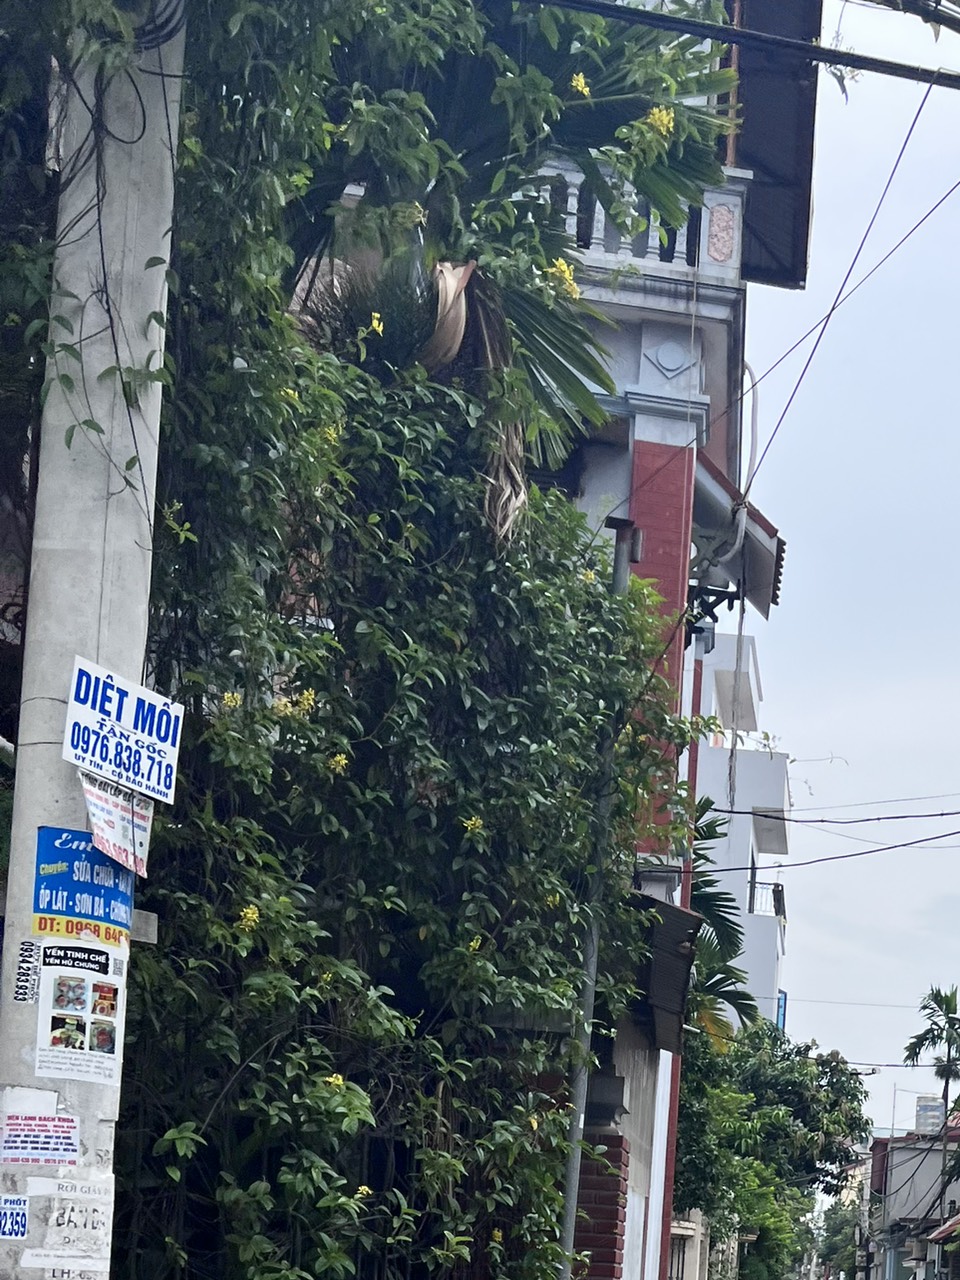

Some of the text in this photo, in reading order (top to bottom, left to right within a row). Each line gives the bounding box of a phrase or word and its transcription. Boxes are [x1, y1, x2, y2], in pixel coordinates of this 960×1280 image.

[74, 668, 180, 748] DIỆT MỐI
[71, 721, 173, 790] 0976.838.718
[134, 739, 168, 759] GỐC
[39, 882, 50, 909] ỐP
[52, 886, 68, 911] LÁT
[45, 947, 64, 957] YẾN
[65, 950, 88, 961] TINH
[4, 1198, 27, 1206] PHỐT
